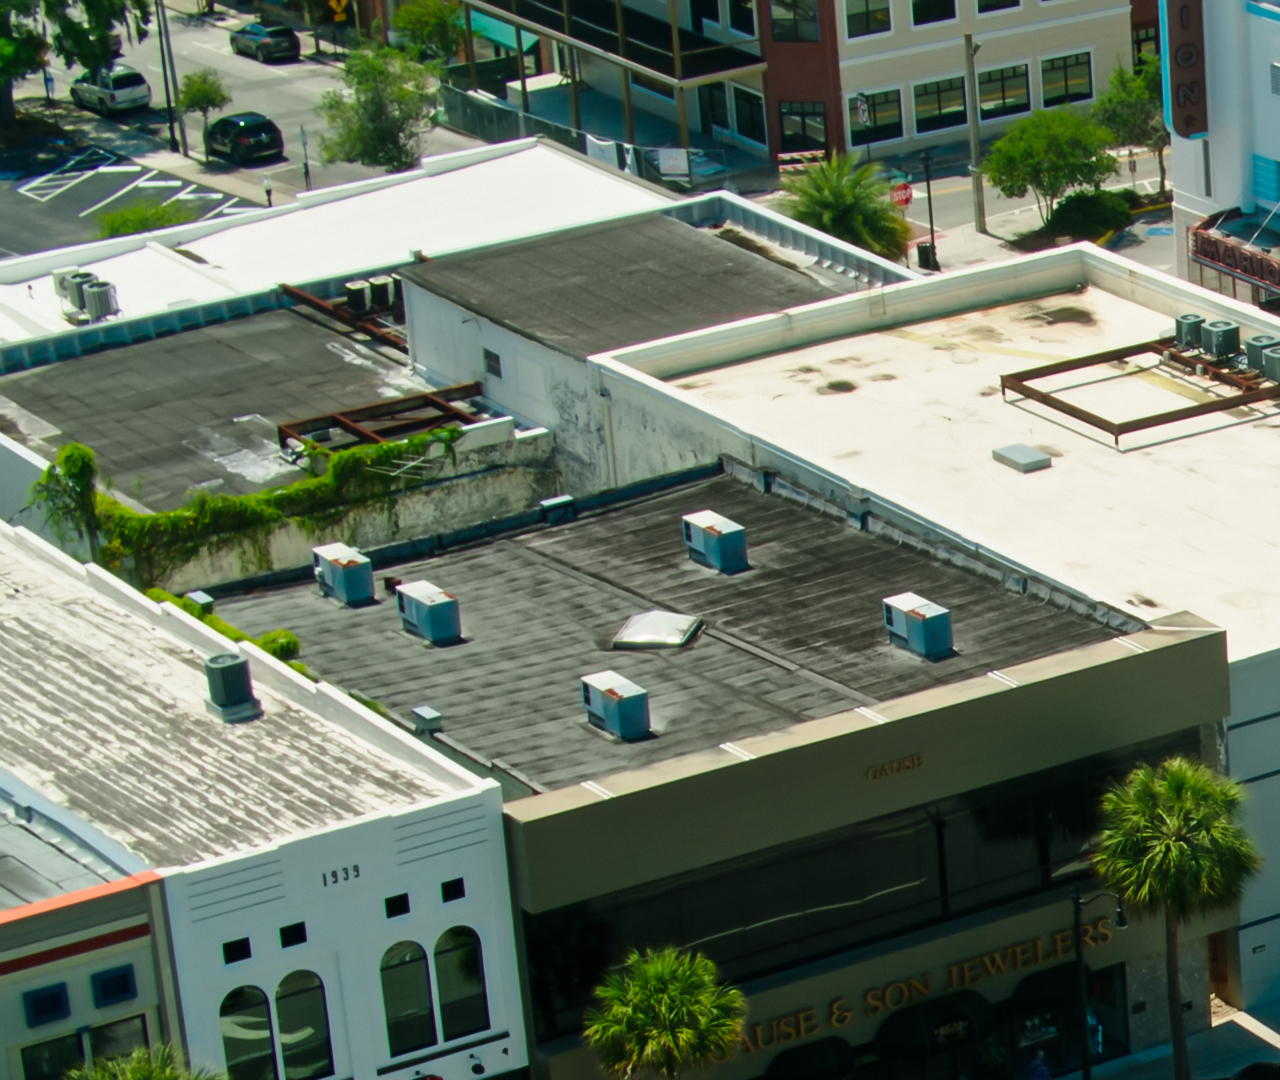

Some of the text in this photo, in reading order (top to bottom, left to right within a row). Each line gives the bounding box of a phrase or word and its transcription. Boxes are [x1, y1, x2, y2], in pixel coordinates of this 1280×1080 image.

[892, 188, 912, 202] STOP
[866, 752, 923, 781] GAUSE
[322, 864, 360, 887] 1939
[829, 997, 854, 1028] &
[864, 972, 933, 1017] SON
[945, 917, 1113, 993] JEWELERS
